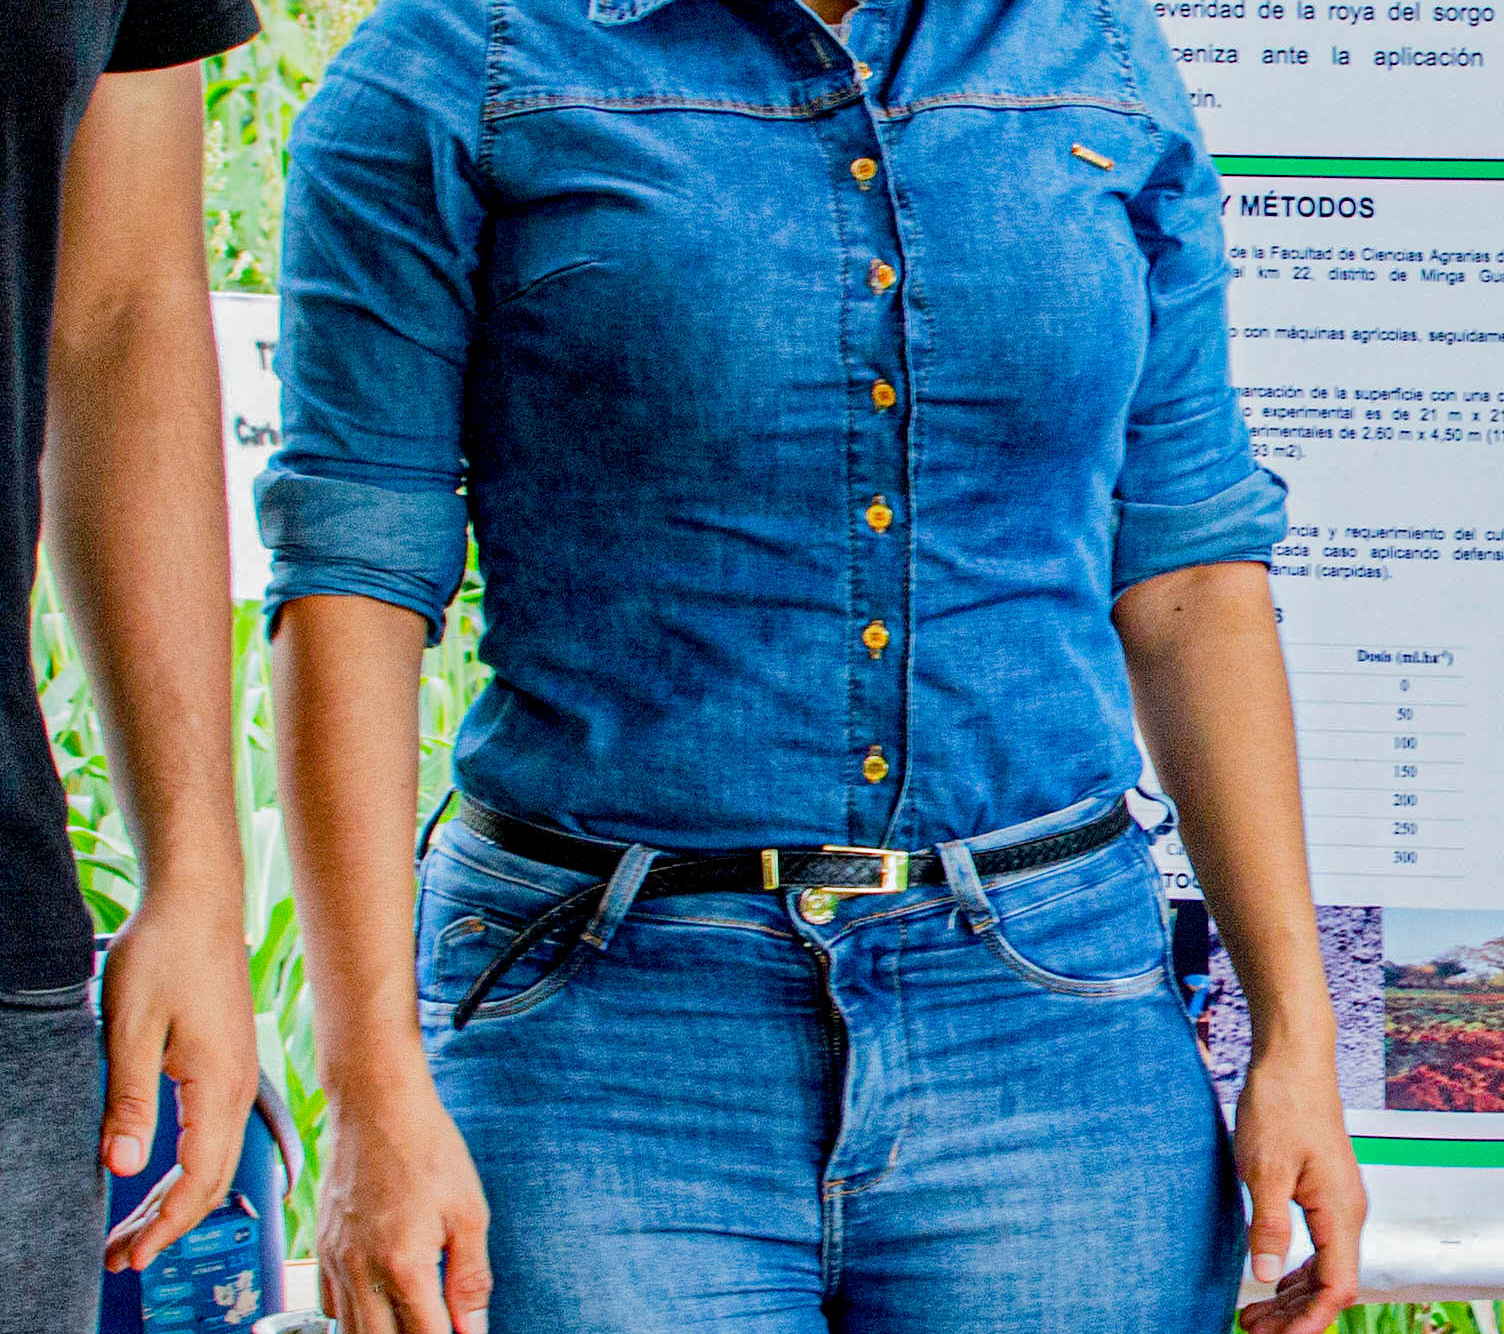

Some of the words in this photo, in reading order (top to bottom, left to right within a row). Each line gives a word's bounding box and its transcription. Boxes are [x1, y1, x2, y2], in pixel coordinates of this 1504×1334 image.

[1154, 0, 1246, 19] everidad
[1258, 0, 1285, 19] de
[1297, 0, 1316, 20] la
[1328, 5, 1376, 25] roya
[1388, 2, 1420, 21] del
[1432, 6, 1495, 27] sorgo
[1262, 47, 1309, 65] ante
[1332, 46, 1351, 65] la
[1374, 47, 1484, 71] aplicación
[1240, 190, 1376, 219] MÉTODOS
